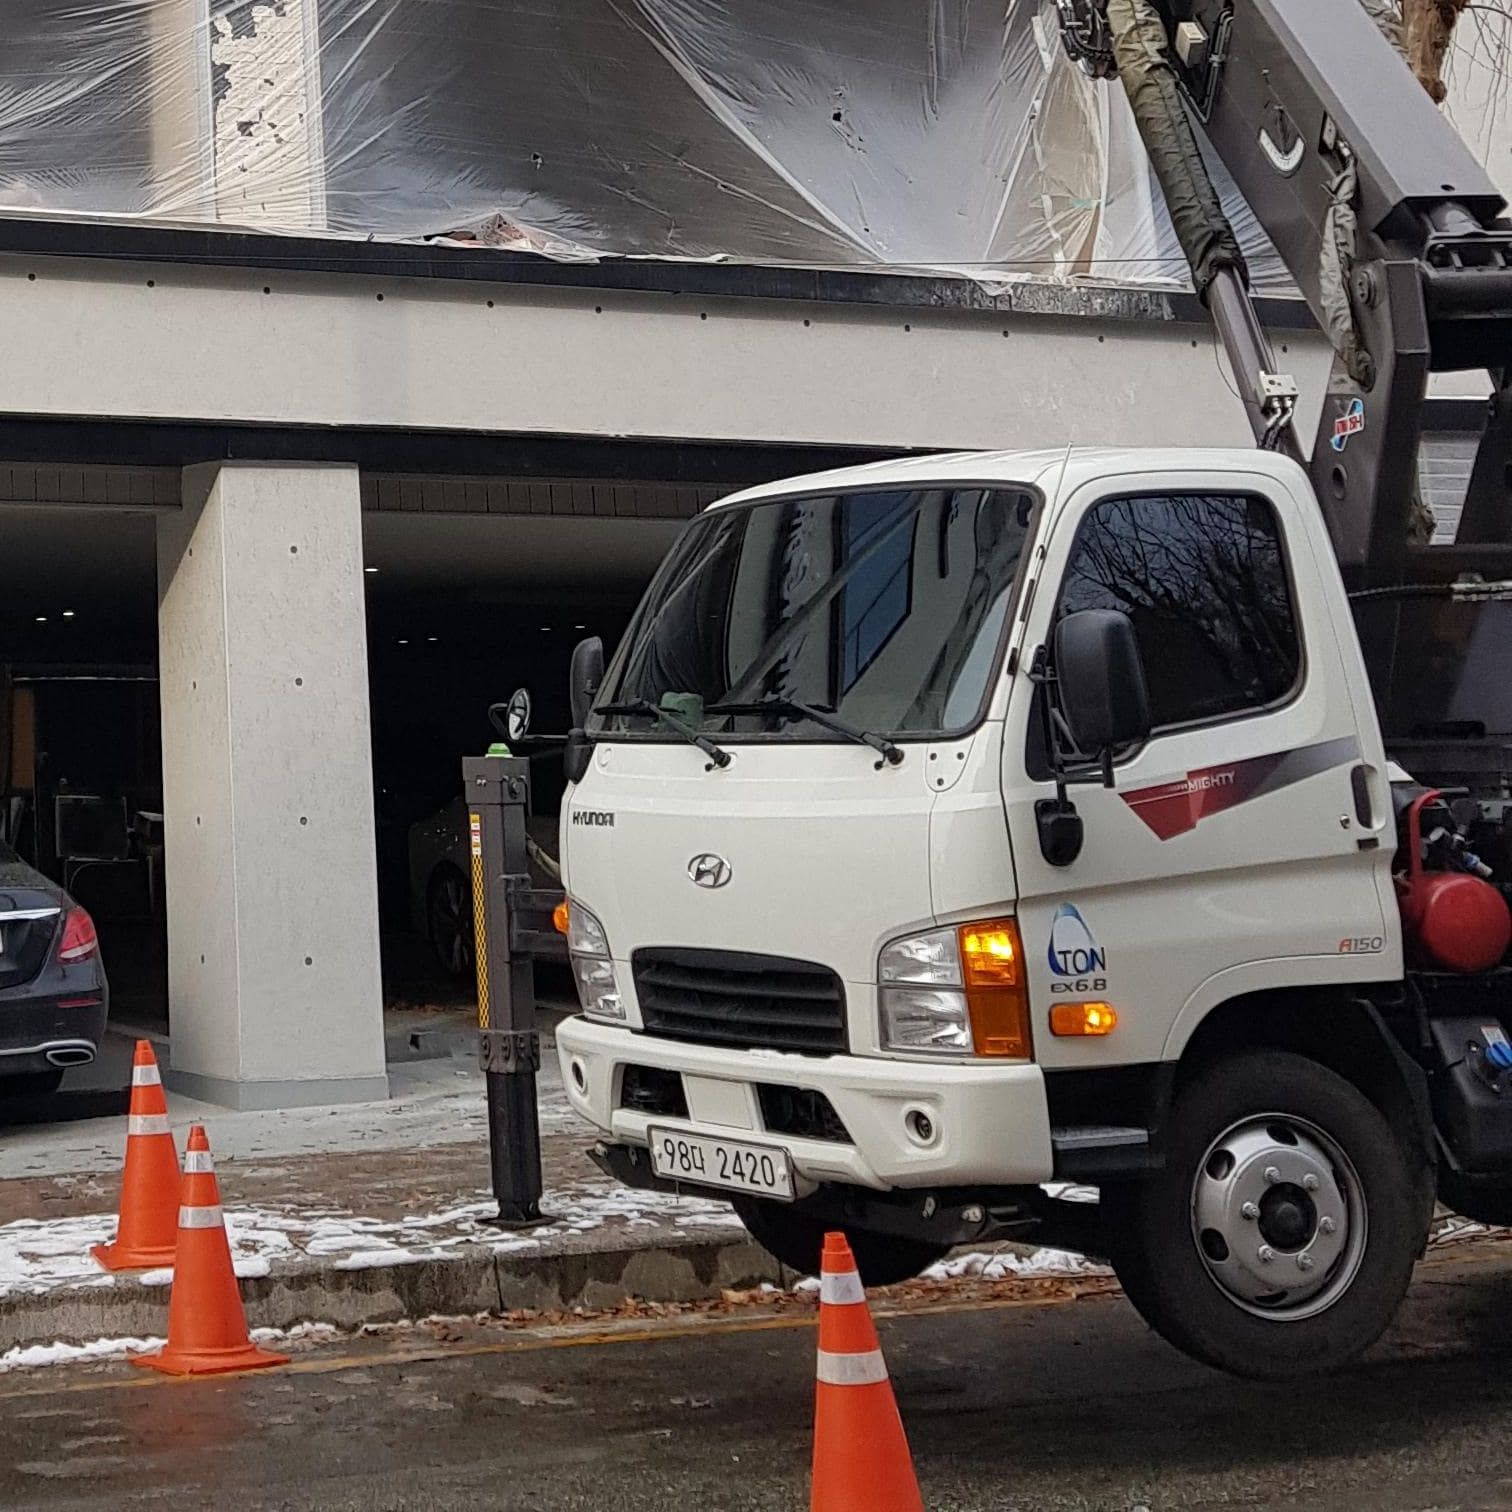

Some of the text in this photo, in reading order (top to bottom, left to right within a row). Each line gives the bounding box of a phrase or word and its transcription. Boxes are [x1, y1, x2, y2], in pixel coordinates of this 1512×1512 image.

[1187, 770, 1236, 792] MIGHTY
[572, 810, 615, 827] HYUNDAI
[1050, 978, 1107, 994] EX6.8
[663, 1138, 776, 1188] 98다 2420
